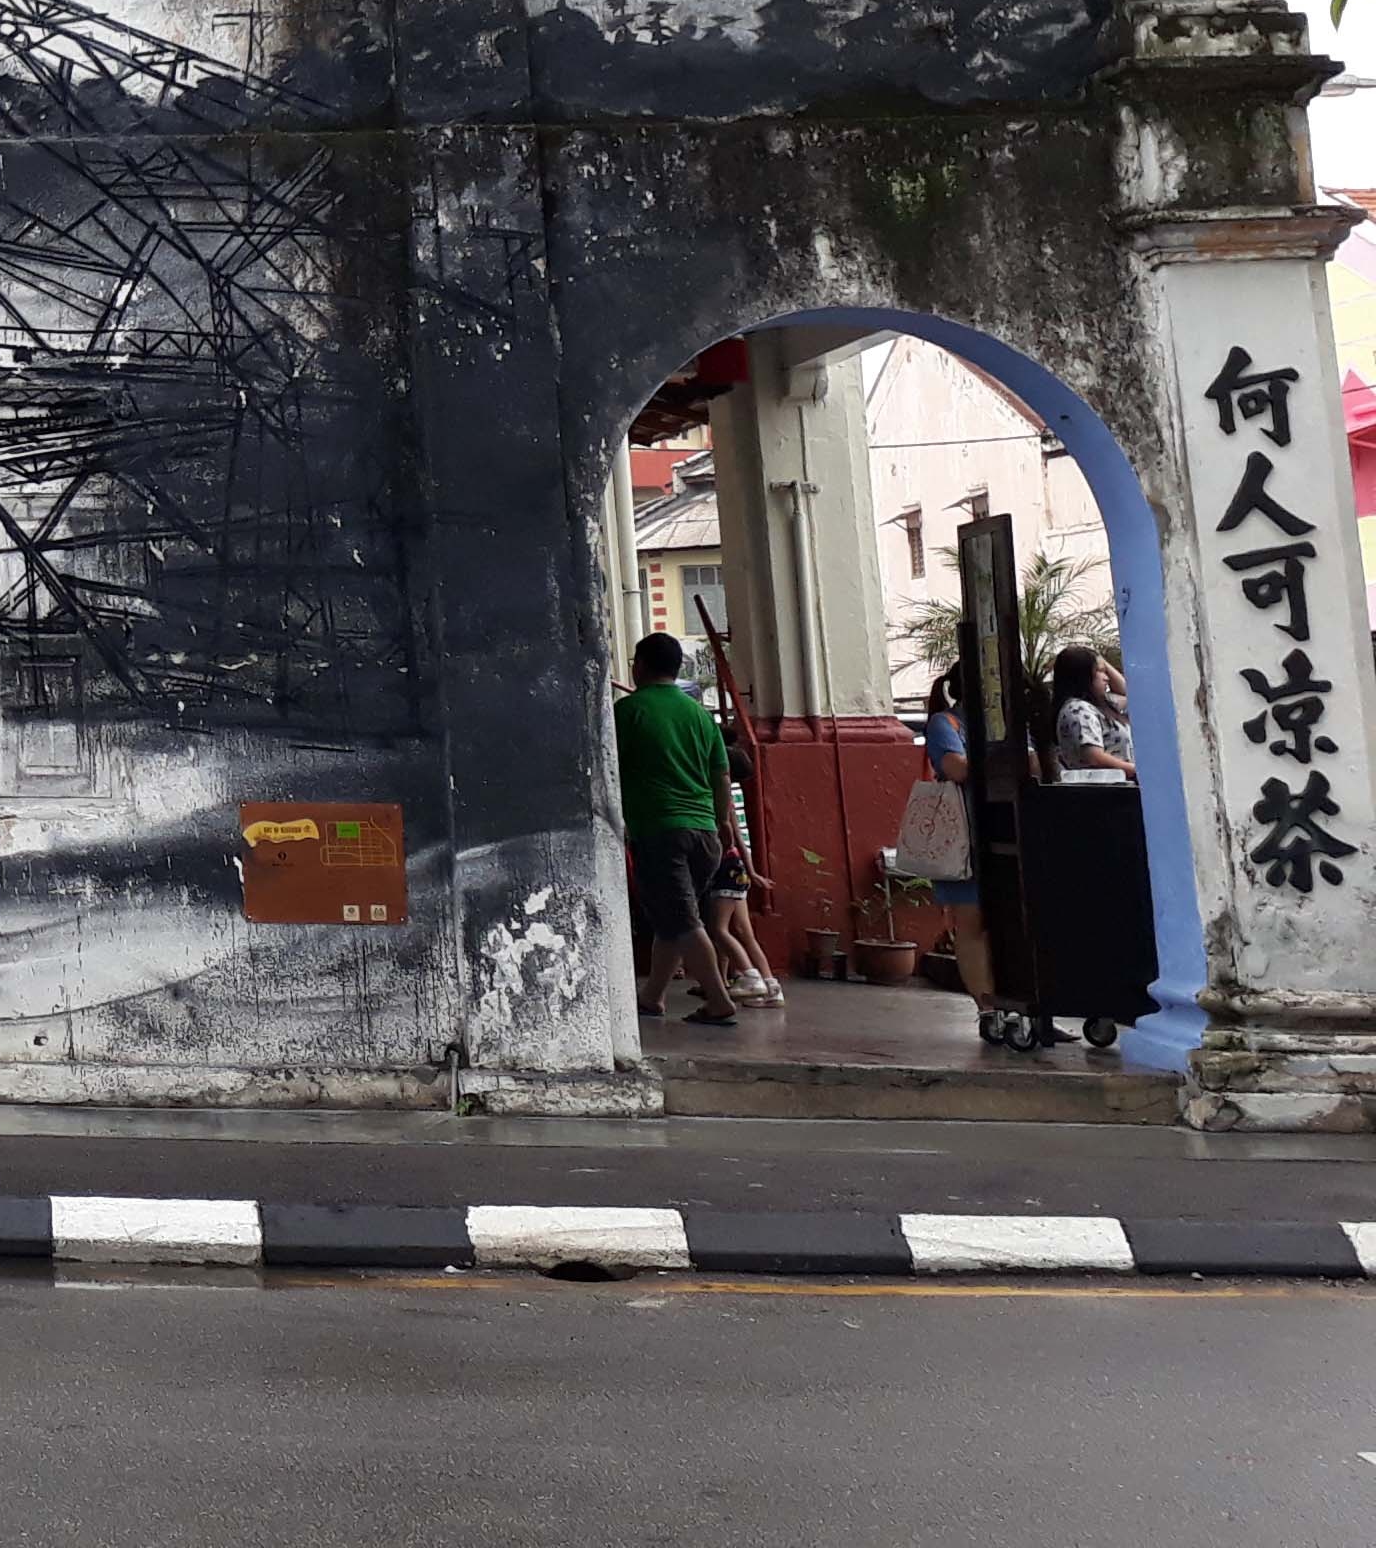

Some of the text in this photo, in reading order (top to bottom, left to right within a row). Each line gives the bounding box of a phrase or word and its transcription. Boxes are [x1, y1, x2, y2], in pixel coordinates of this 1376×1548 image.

[1204, 346, 1359, 894] 何人可凉茶
